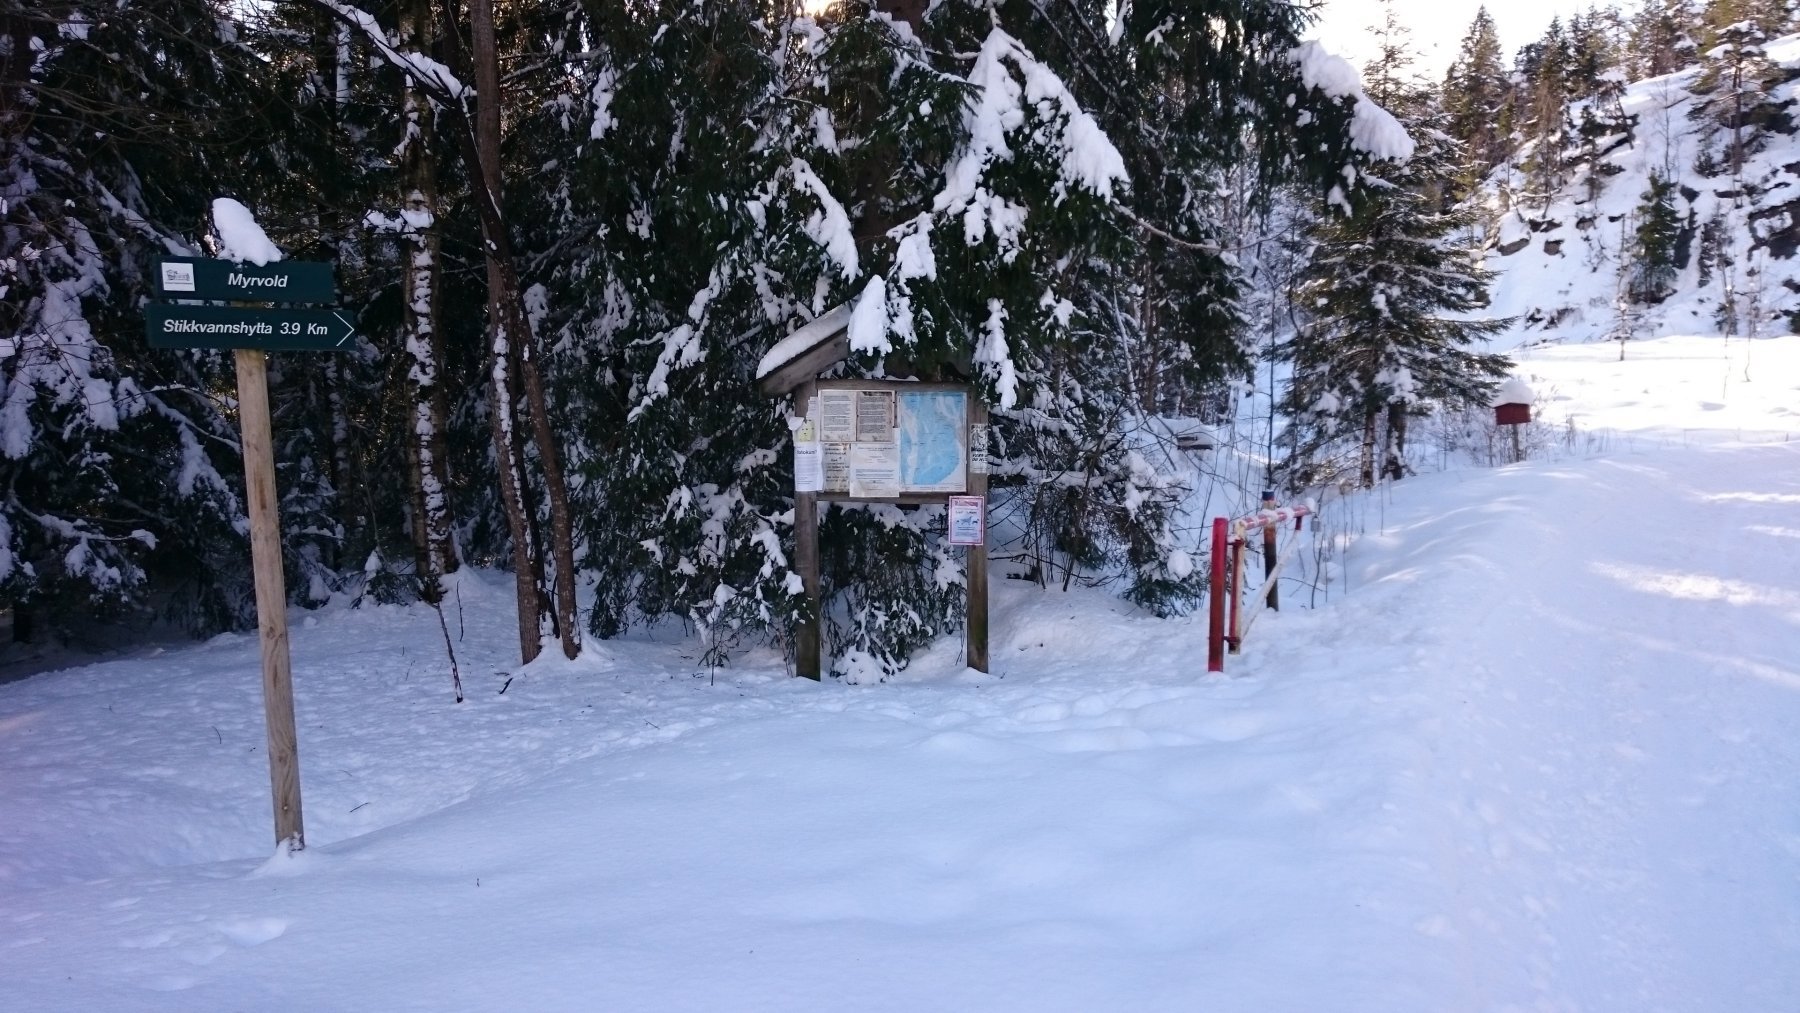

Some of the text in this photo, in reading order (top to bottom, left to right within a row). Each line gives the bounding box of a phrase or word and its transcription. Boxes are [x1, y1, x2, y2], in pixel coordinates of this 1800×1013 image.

[228, 273, 288, 289] Myrvold
[163, 319, 328, 336] Stikkvannshytta 3.9 Km
